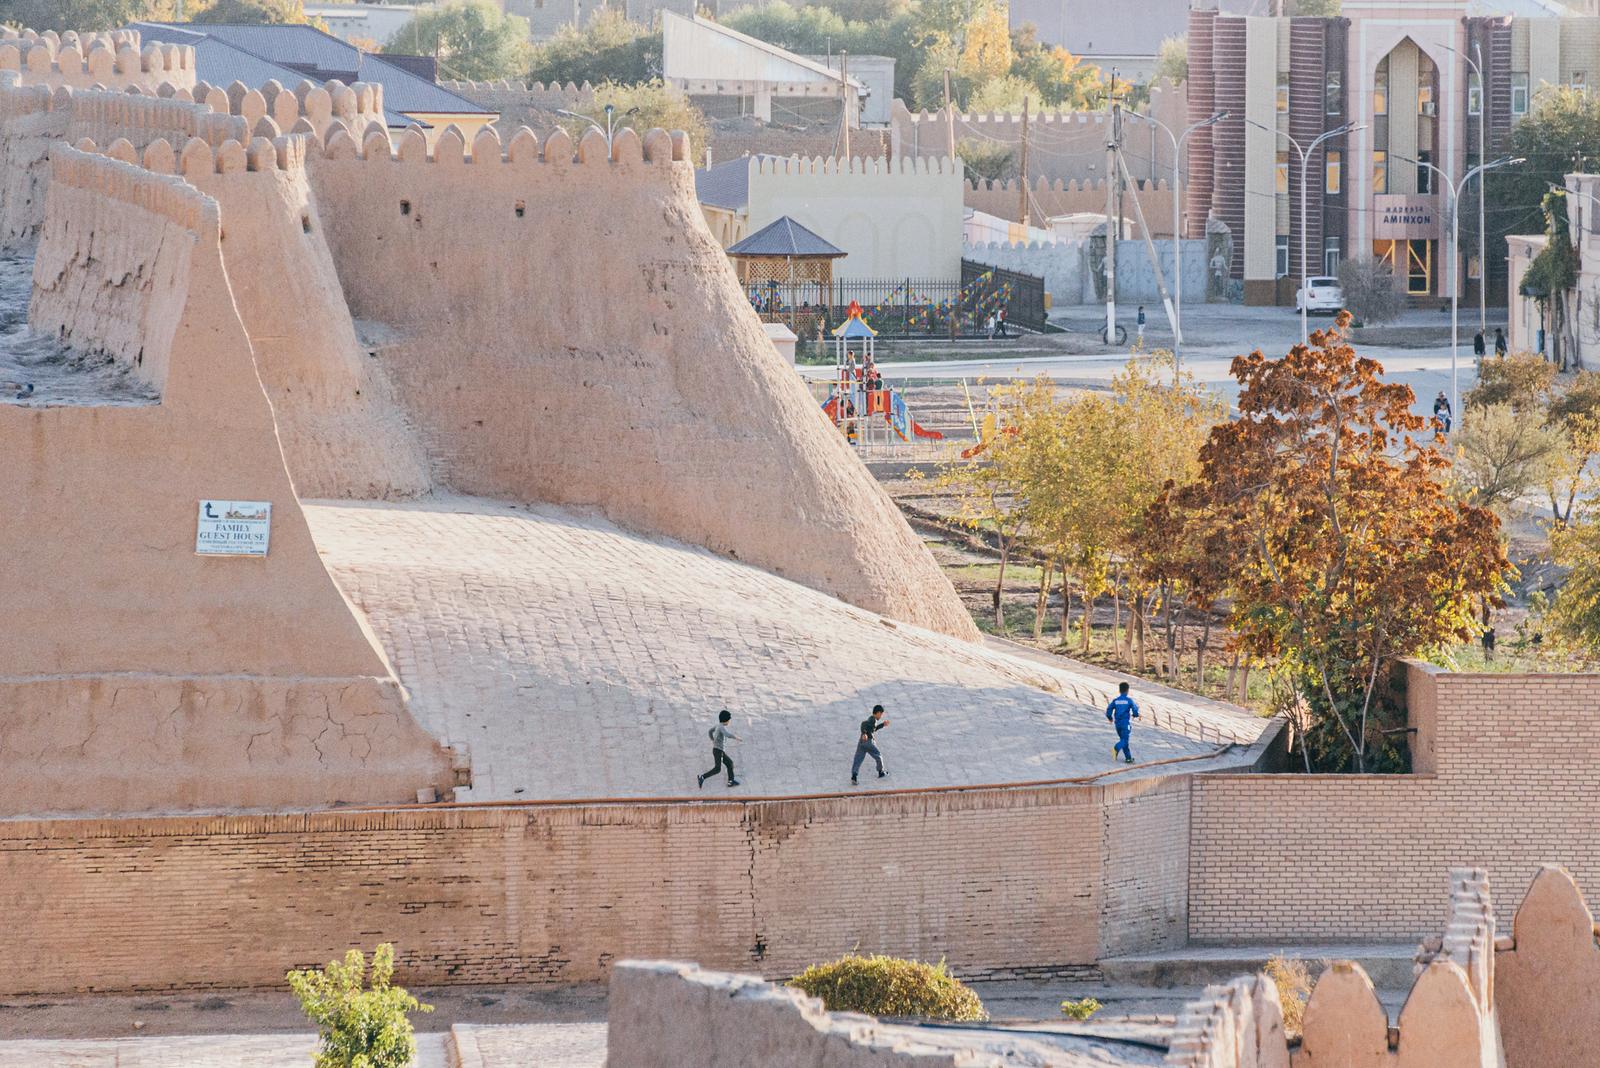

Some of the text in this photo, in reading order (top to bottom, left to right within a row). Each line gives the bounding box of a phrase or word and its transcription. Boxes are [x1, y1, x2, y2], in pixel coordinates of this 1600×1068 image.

[1383, 215, 1431, 224] AMINXON
[215, 523, 250, 532] FAMILY
[199, 531, 265, 541] GUEST HOUSE
